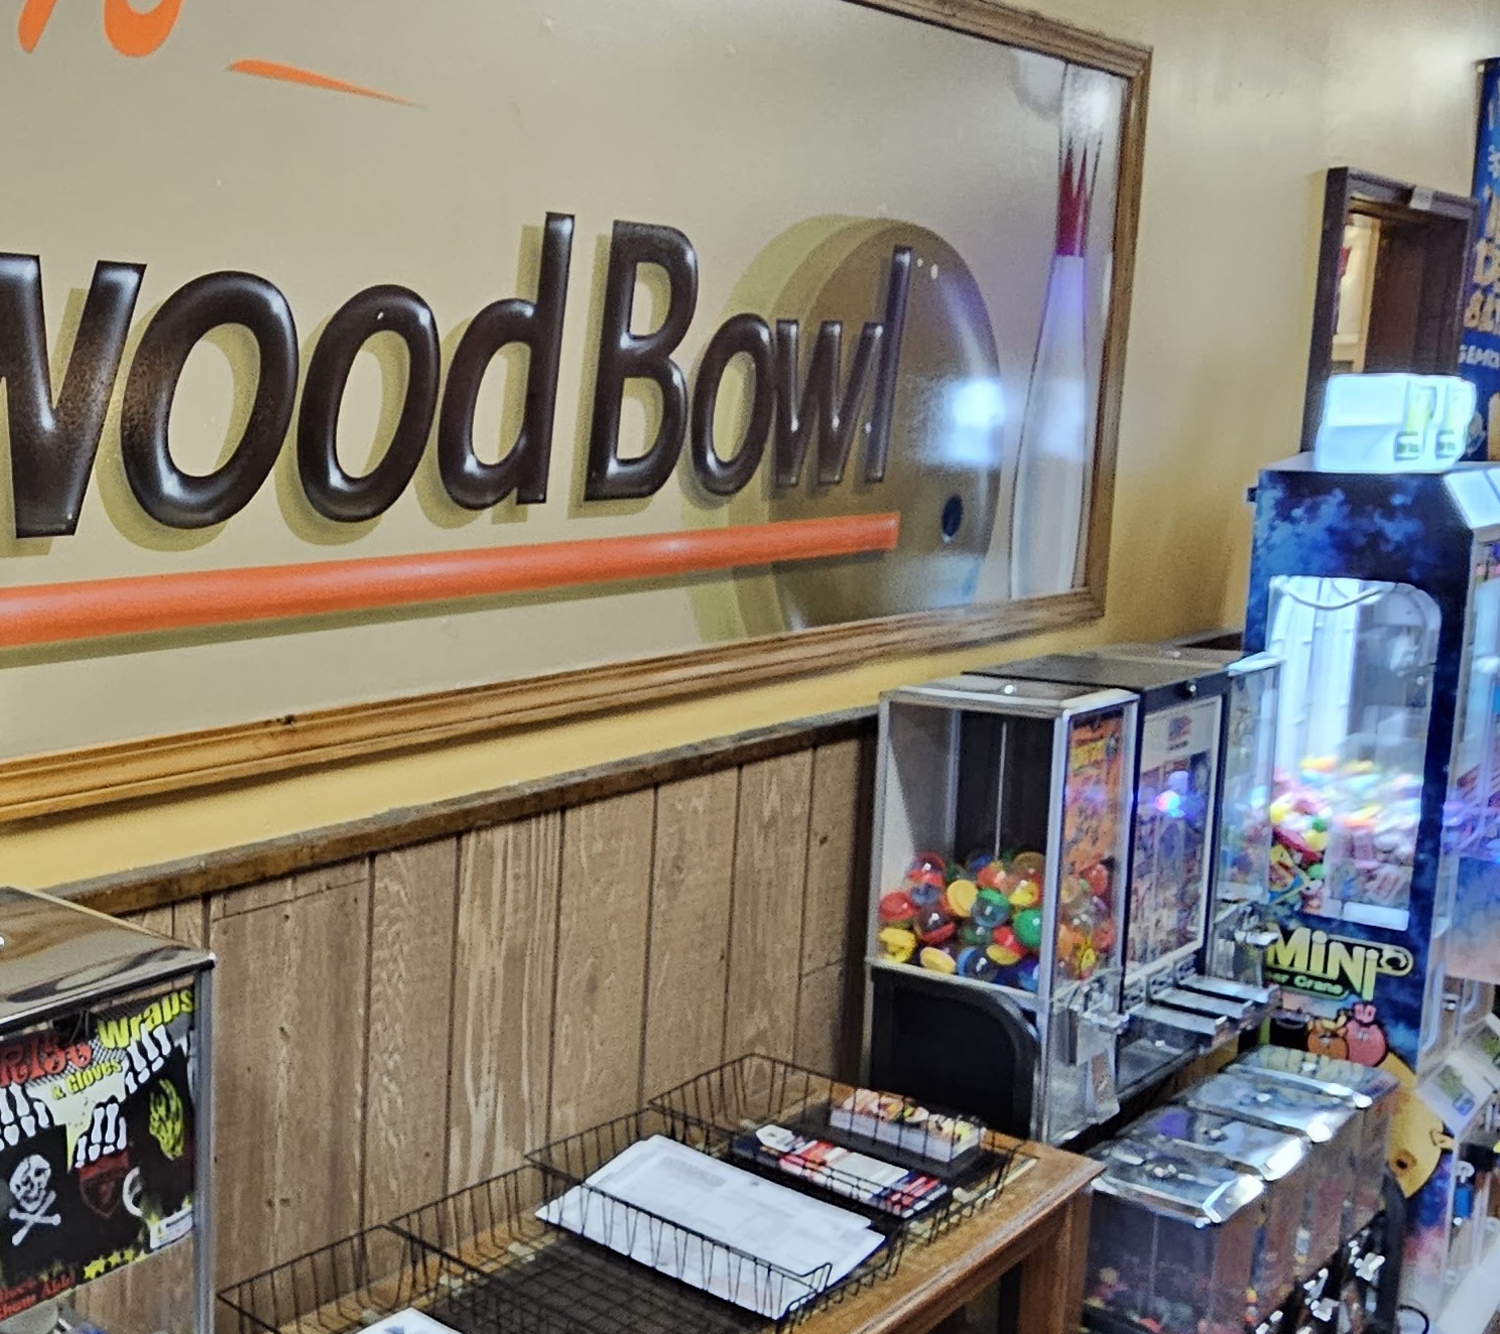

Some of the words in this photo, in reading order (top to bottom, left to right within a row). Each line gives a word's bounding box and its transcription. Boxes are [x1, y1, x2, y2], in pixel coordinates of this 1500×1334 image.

[583, 218, 914, 502] Bowl
[97, 989, 194, 1050] Wraps
[65, 1059, 122, 1095] Gloves
